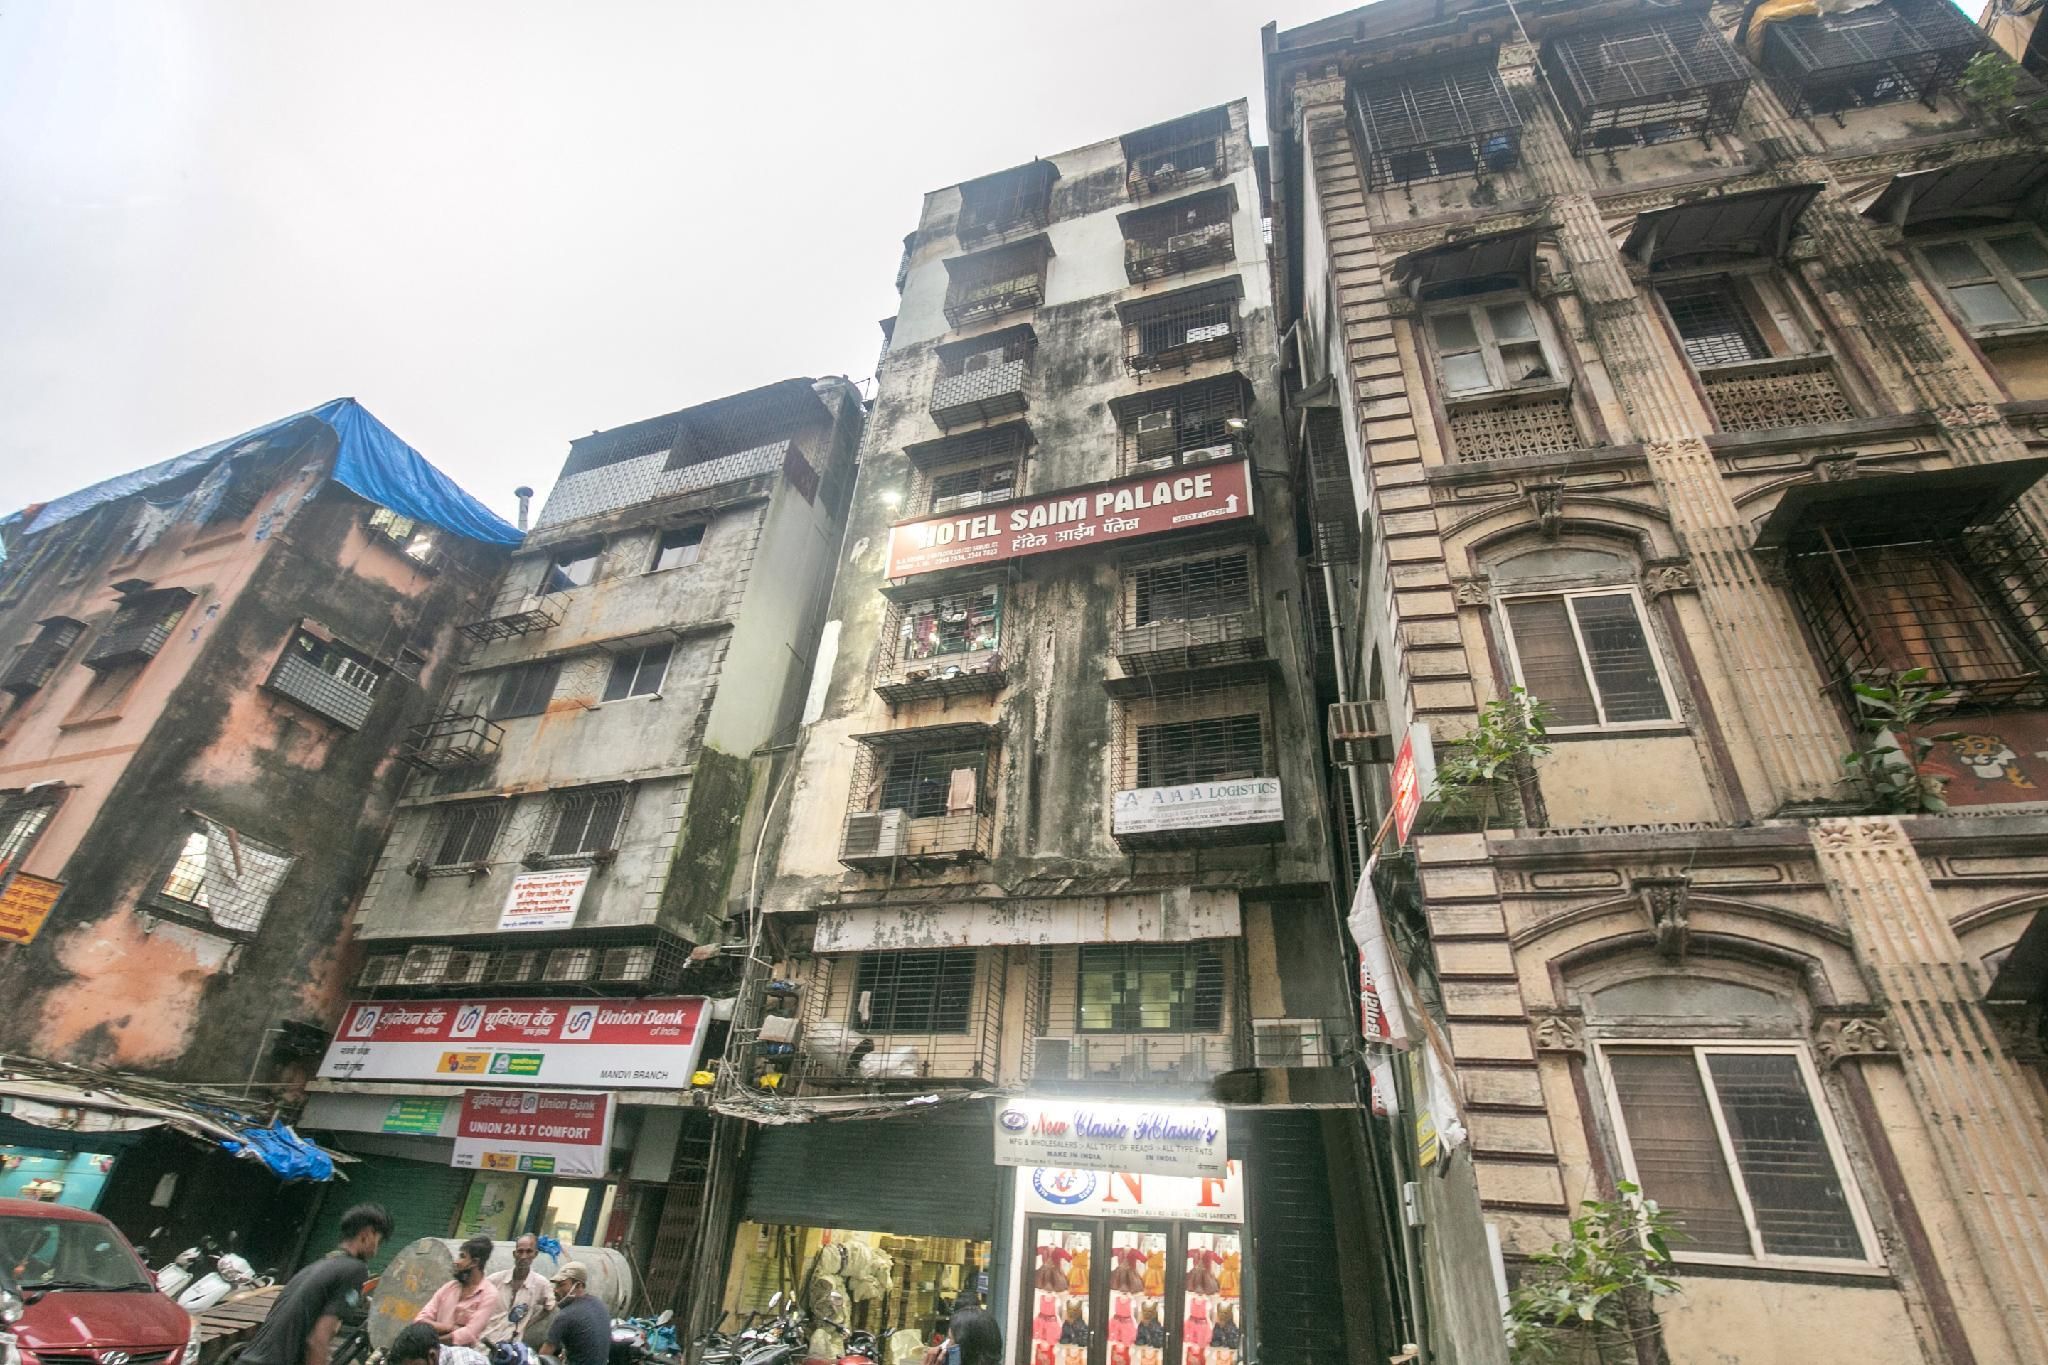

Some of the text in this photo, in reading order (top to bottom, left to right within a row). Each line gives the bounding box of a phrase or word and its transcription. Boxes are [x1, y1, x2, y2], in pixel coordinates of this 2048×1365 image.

[916, 473, 1213, 550] HOTEL SAIM PALACE
[1054, 522, 1097, 543] साईम
[1208, 781, 1278, 799] LOGISTICS
[484, 1007, 534, 1032] यूनियन
[597, 1009, 687, 1025] Union Bank
[649, 1026, 680, 1036] of India
[600, 1070, 669, 1080] MANDVI BRANCH
[539, 1097, 595, 1111] Union Bank
[469, 1121, 592, 1139] UNION 24 X 7 COMFORT
[1031, 1112, 1070, 1136] New
[1074, 1110, 1130, 1139] Classic
[1031, 1139, 1078, 1149] WHOLESALERS
[1081, 1152, 1102, 1160] INDIA
